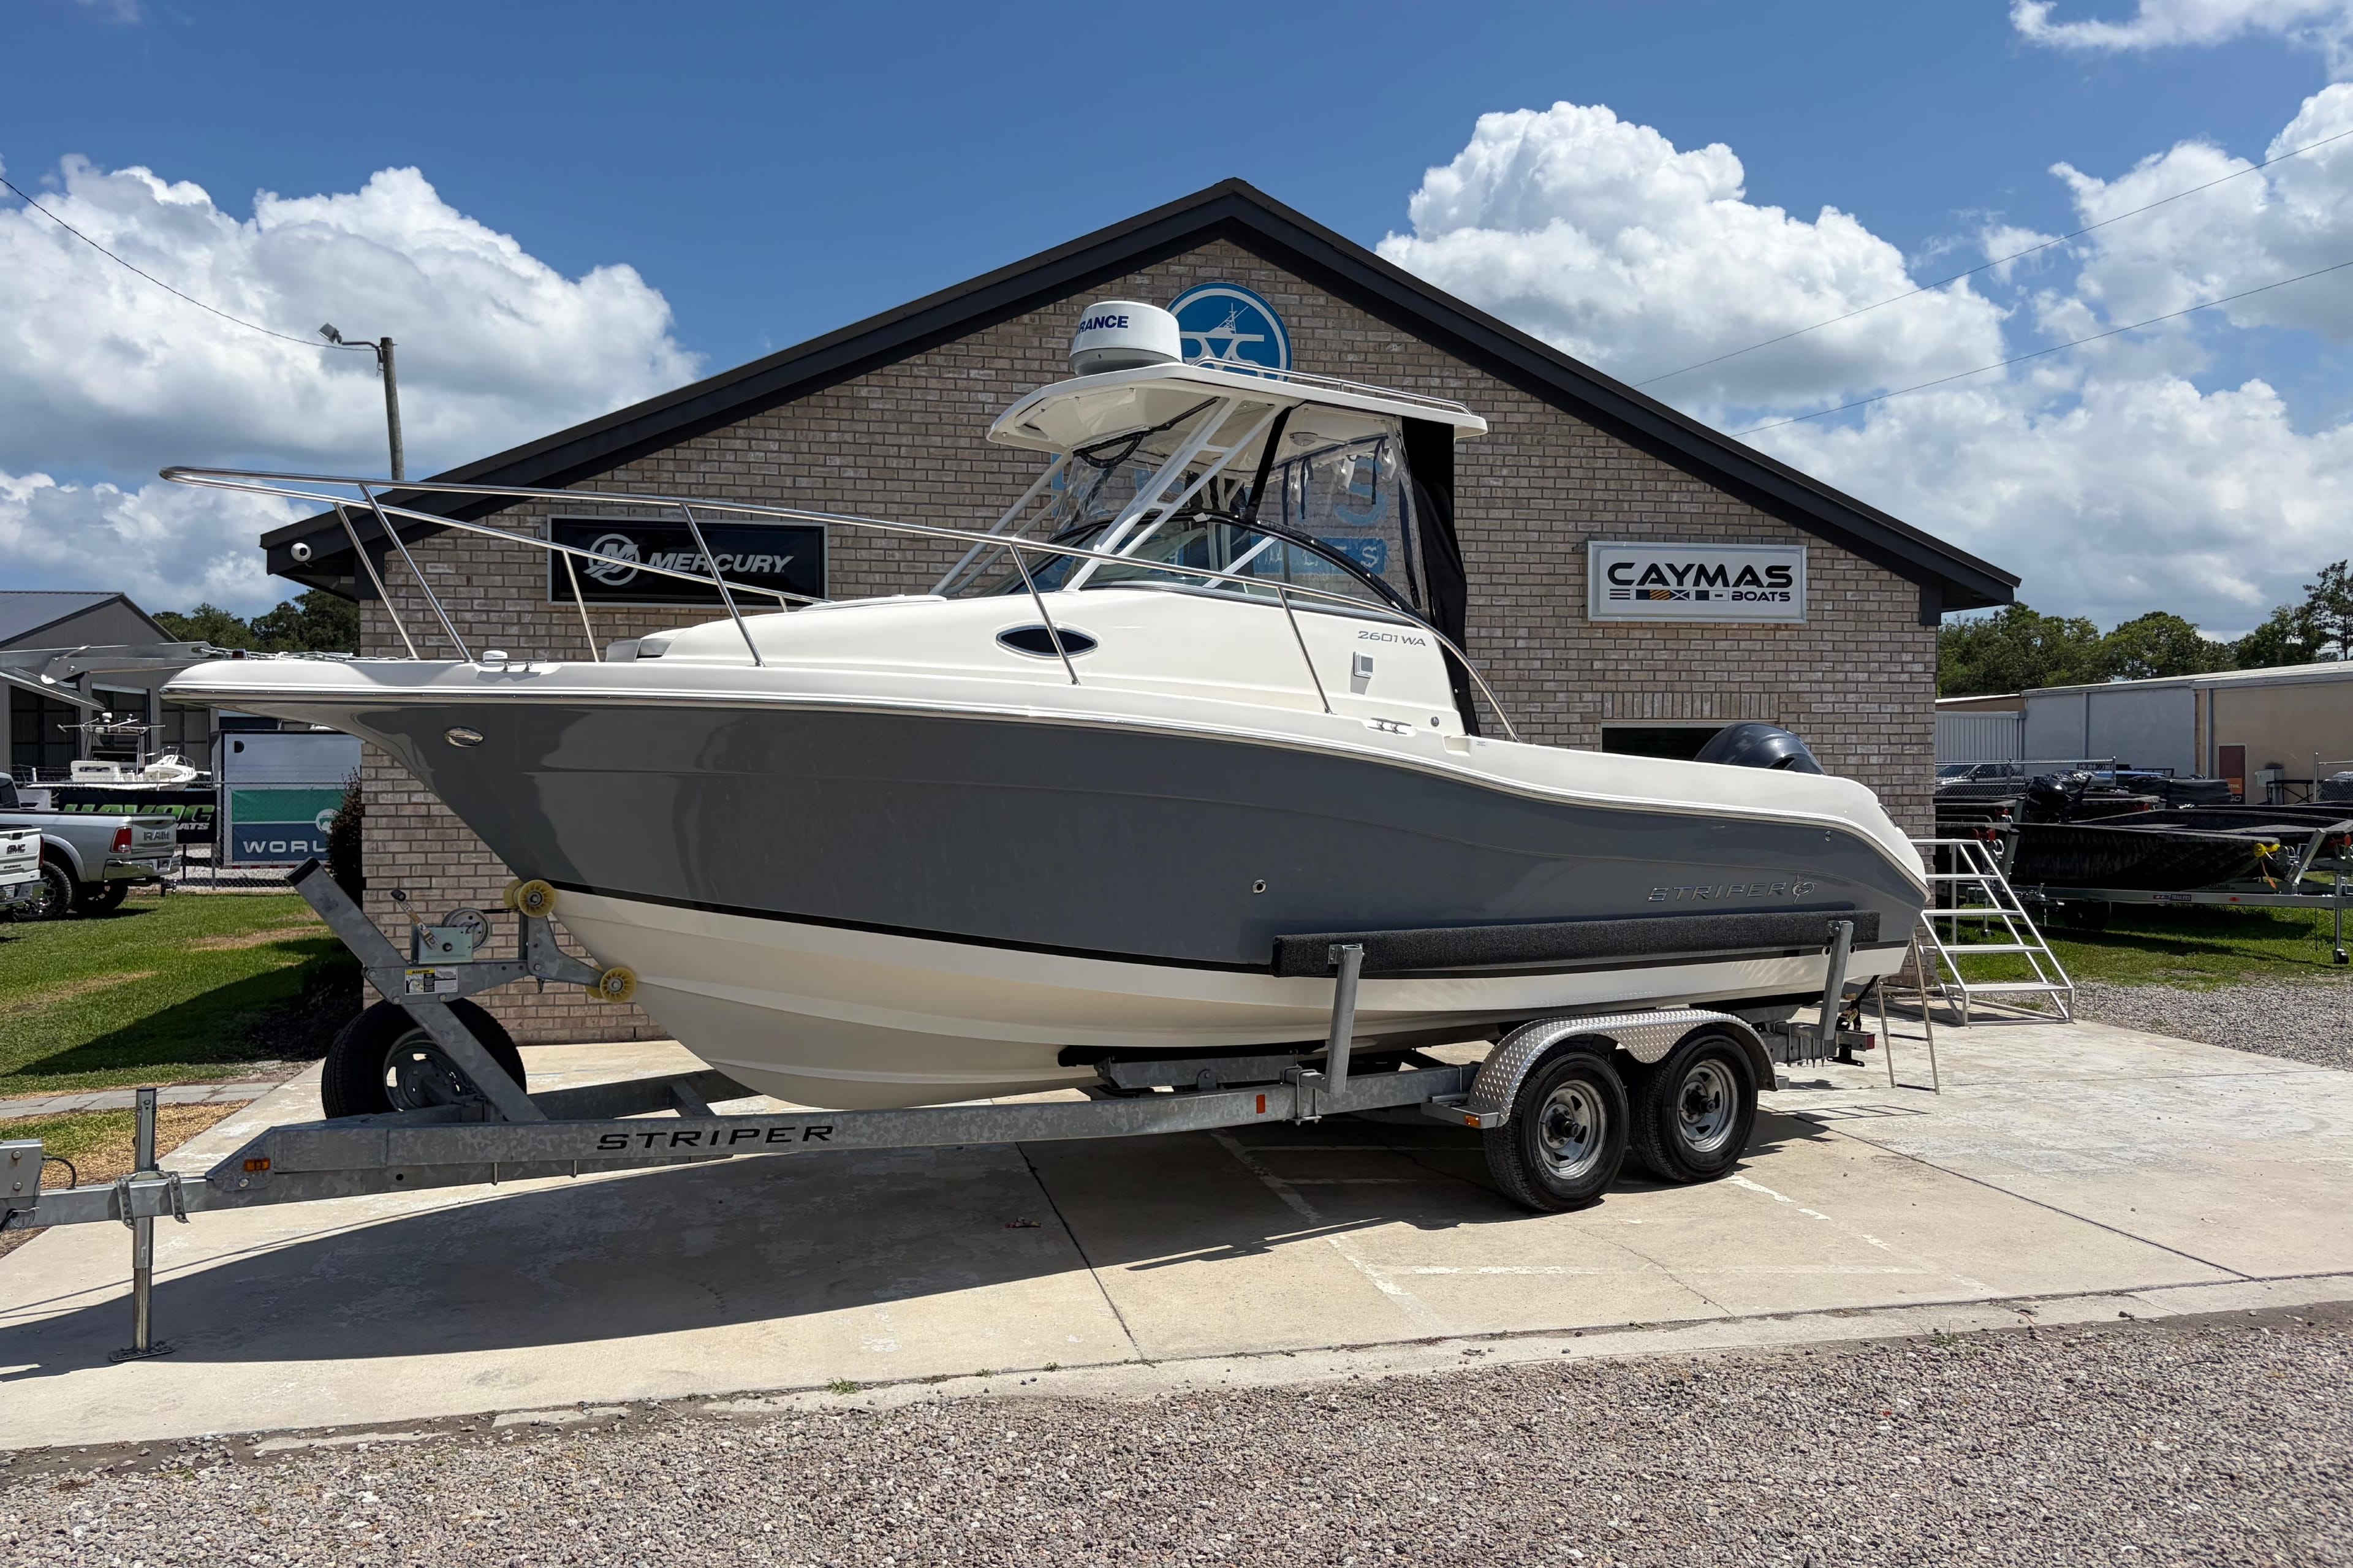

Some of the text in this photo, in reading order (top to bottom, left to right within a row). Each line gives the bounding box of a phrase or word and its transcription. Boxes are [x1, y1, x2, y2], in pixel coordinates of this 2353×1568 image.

[648, 553, 794, 573] MERCURY
[1607, 562, 1793, 589] CAYMAS
[1731, 591, 1790, 602] BOATS
[143, 829, 170, 841] RAM
[1647, 882, 1787, 902] STRIPER
[596, 1126, 833, 1150] STRIPER
